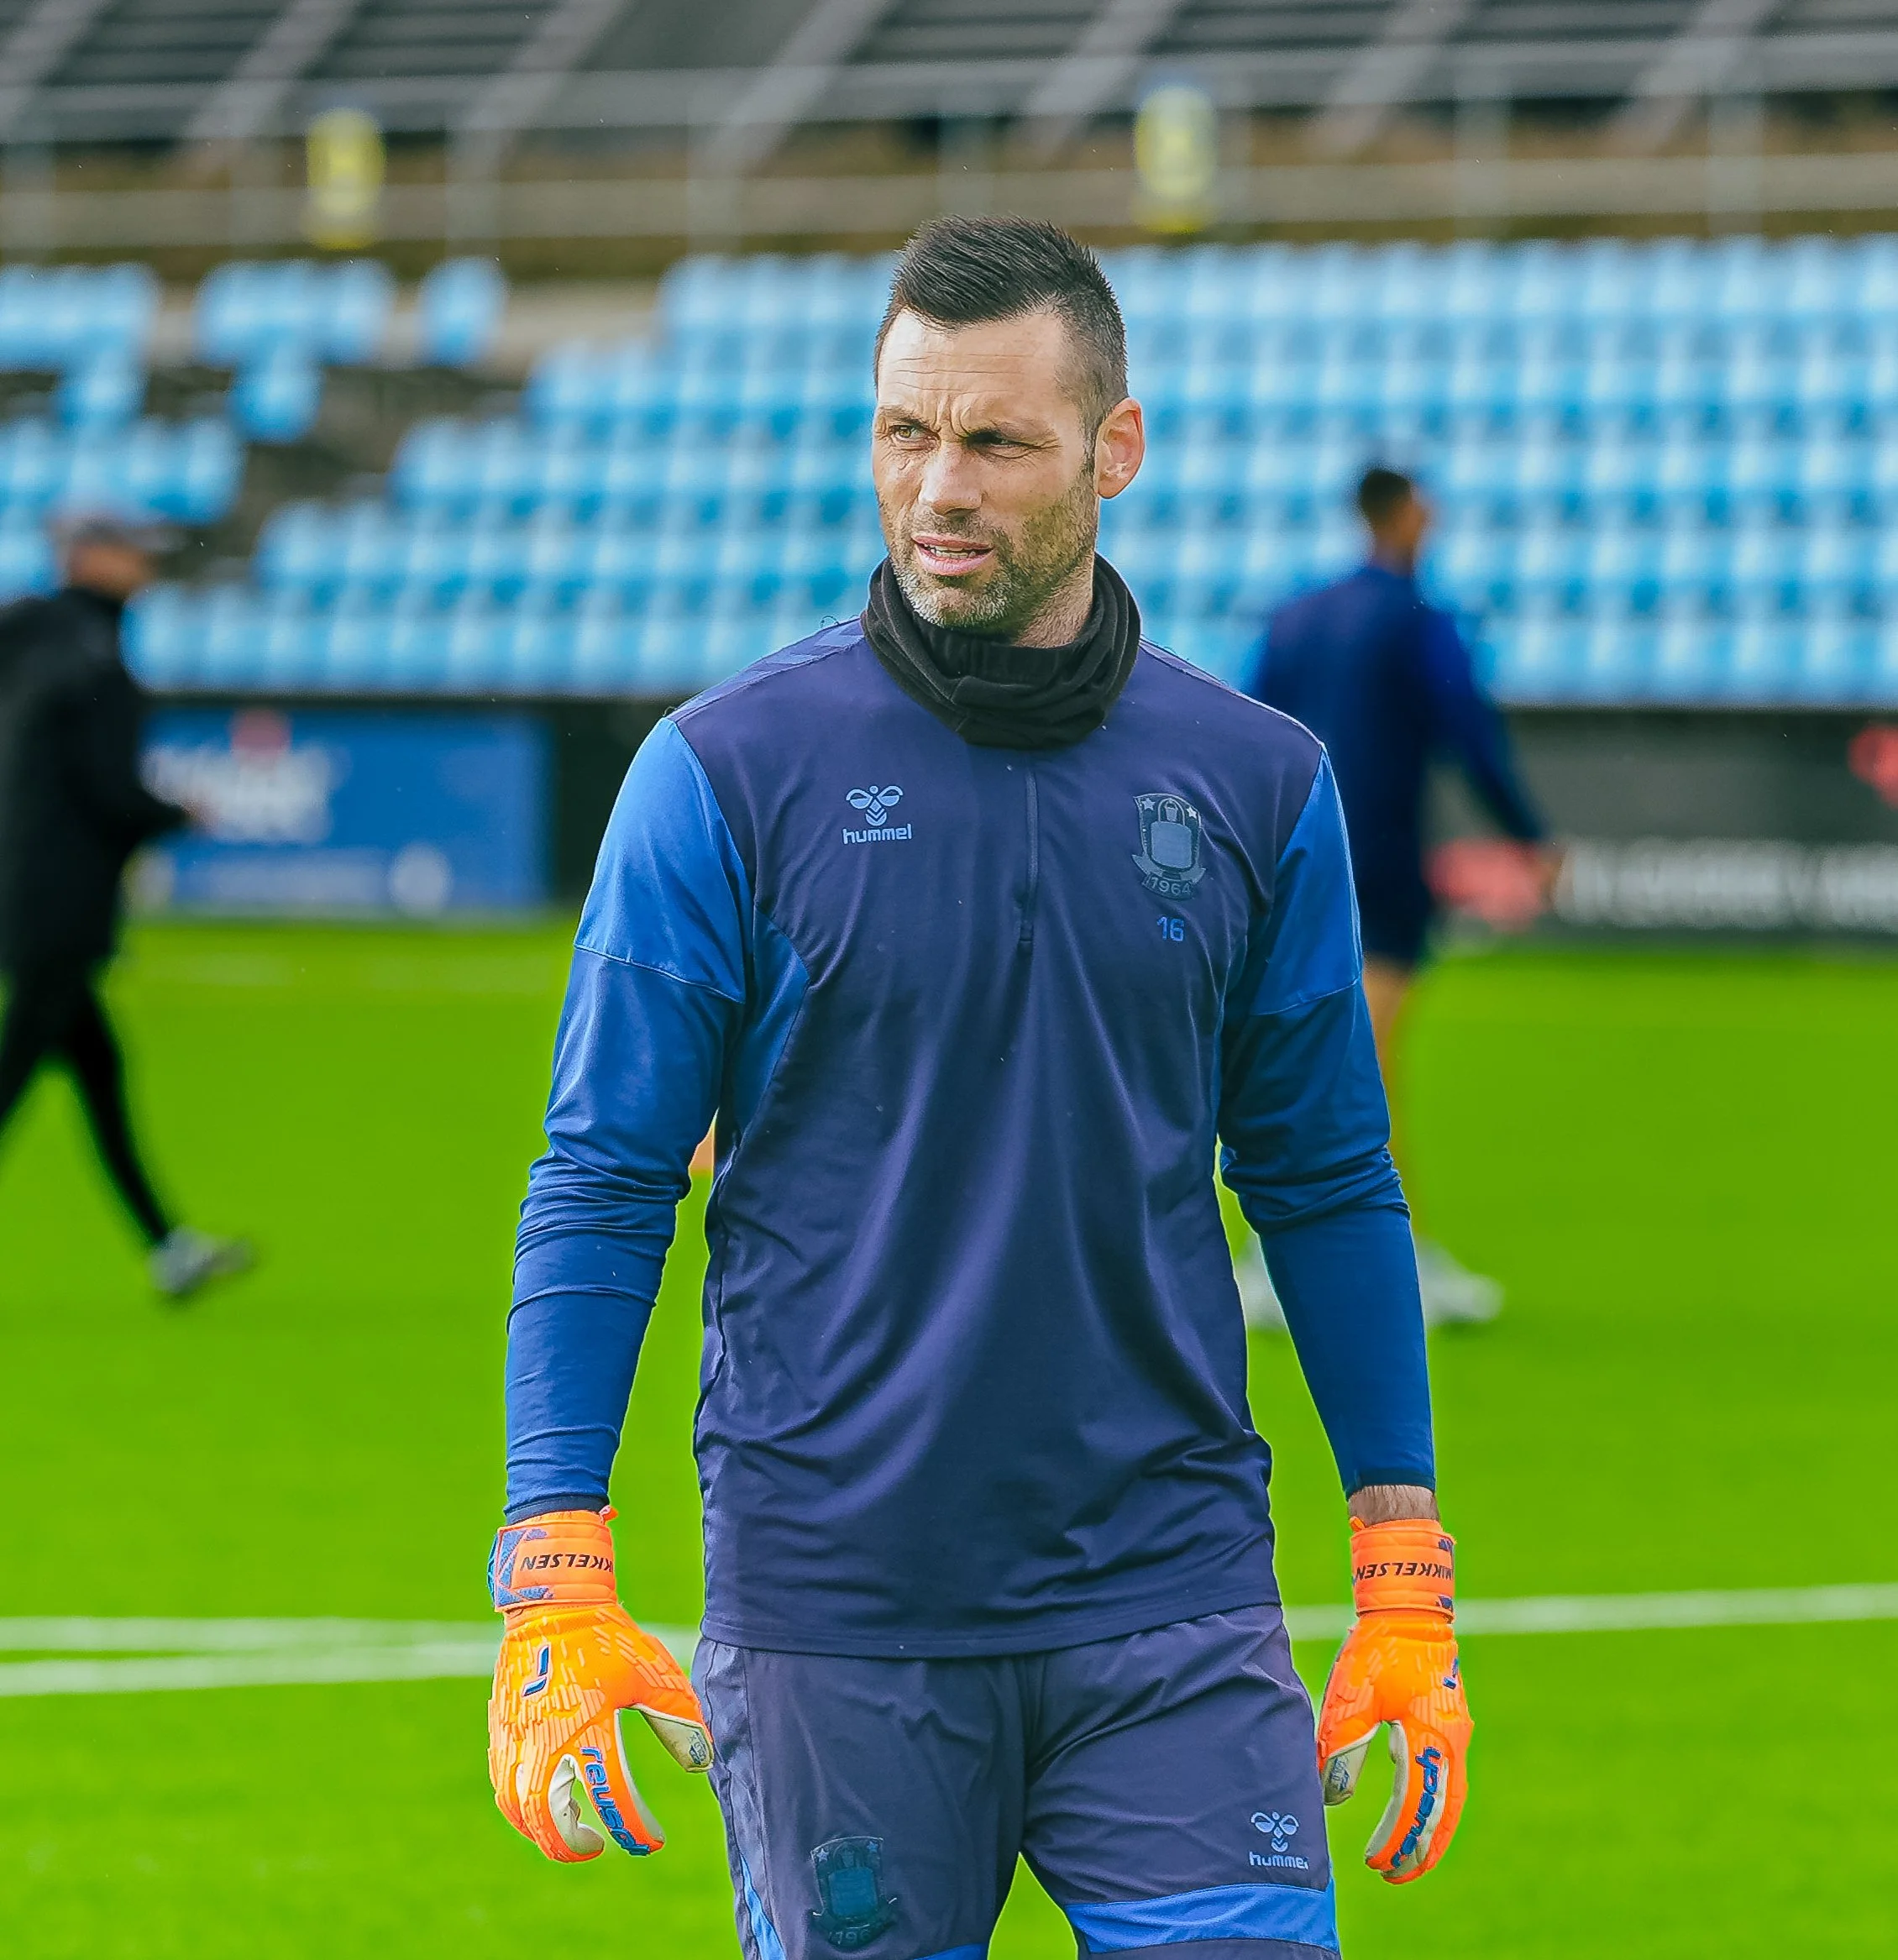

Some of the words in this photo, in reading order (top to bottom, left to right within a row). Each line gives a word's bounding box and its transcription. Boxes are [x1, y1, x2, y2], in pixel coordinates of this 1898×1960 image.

[842, 823, 912, 845] hummel
[1150, 876, 1192, 896] 1964
[1156, 916, 1185, 941] 16
[1356, 1562, 1453, 1580] MIKKELSEN
